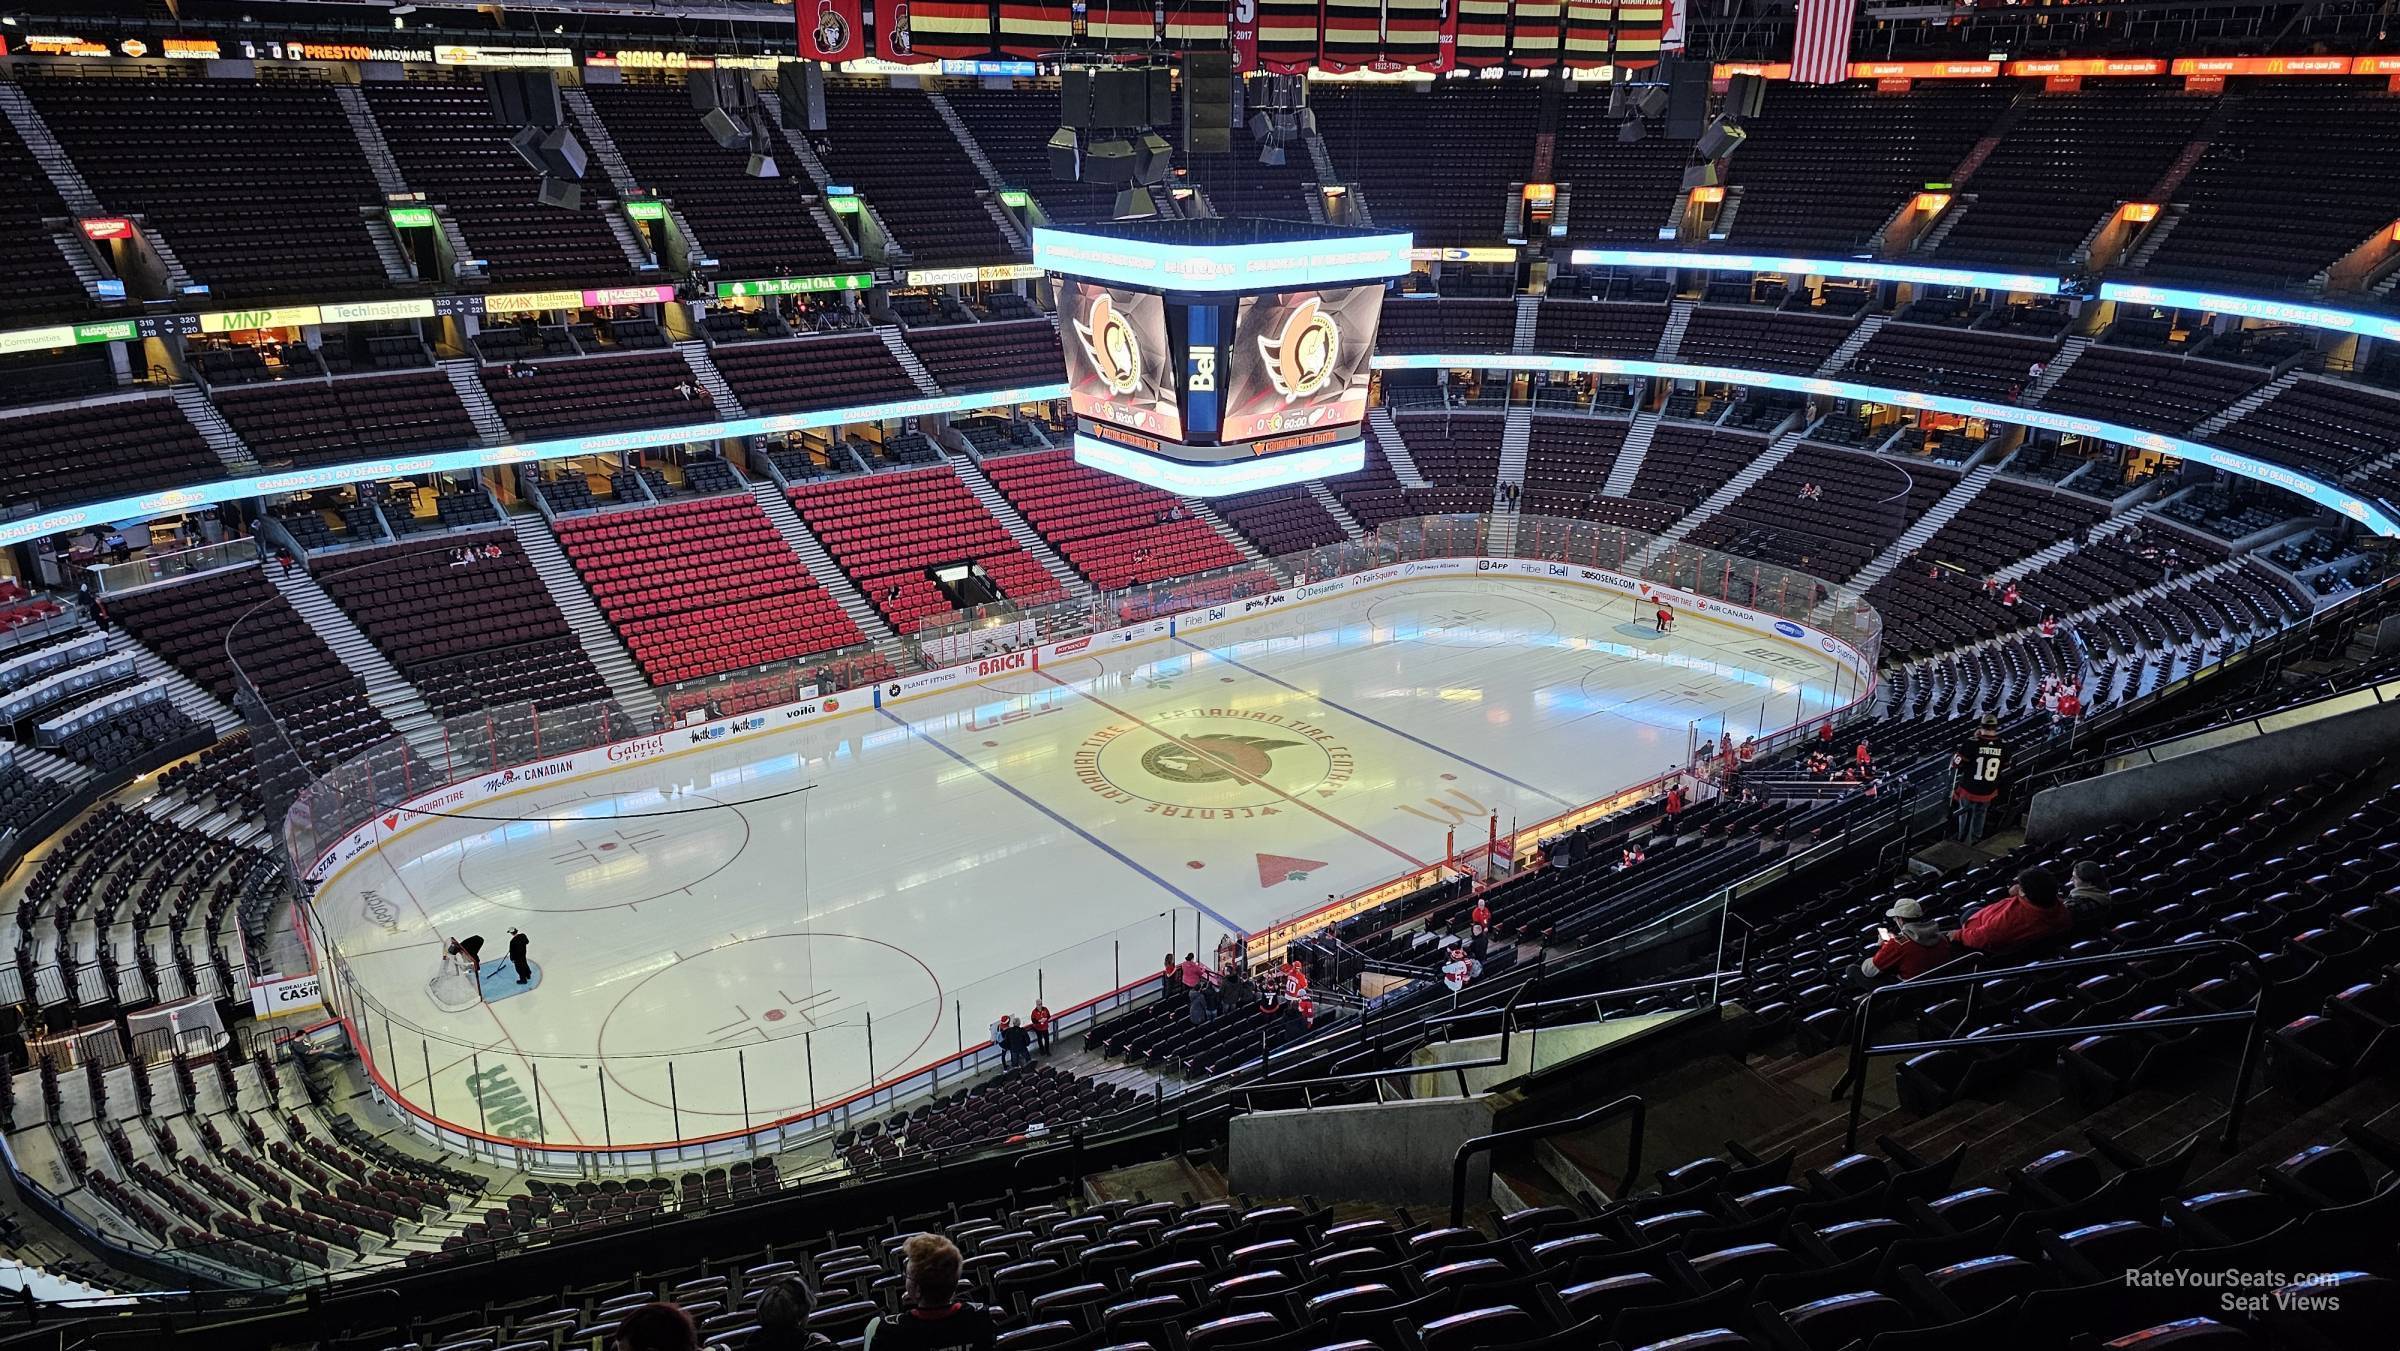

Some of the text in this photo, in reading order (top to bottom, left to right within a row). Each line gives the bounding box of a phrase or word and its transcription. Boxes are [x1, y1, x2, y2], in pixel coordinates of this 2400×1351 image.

[616, 50, 687, 68] SIGNS.CA
[925, 271, 974, 282] Decisive
[980, 267, 1012, 278] RE/MAX
[756, 276, 836, 293] The Royal Oak
[334, 302, 420, 318] TechInsights
[488, 295, 534, 310] RE/MAX
[179, 316, 196, 324] 320
[223, 311, 272, 330] MNP
[142, 329, 157, 337] 219
[182, 326, 198, 334] 220
[4, 334, 61, 348] Communities
[1189, 346, 1215, 392] Bell
[1284, 416, 1307, 428] 60:00
[2039, 416, 2069, 429] DEALER
[2071, 421, 2101, 433] GROUP
[256, 473, 316, 489] CANADA'S
[336, 469, 349, 479] RV
[350, 464, 392, 478] DEALER
[395, 459, 434, 471] GROUP
[0, 513, 87, 539] DEALER GROUP
[1362, 569, 1398, 584] FairSquare
[1521, 563, 1568, 577] Fibe Bell
[1308, 582, 1344, 596] Desjardins
[1185, 607, 1226, 627] Fibe Bell
[1722, 606, 1754, 621] CANADA
[964, 652, 1025, 677] The BRICK
[1744, 648, 1820, 670] BET99
[903, 673, 956, 690] PLANET FITNESS
[786, 703, 816, 720] voilà
[1288, 720, 1335, 742] TIRE
[607, 735, 663, 762] Gabriel
[625, 749, 665, 761] PIZZA
[484, 760, 573, 793] Molson CANADIAN
[1973, 756, 2000, 782] 18
[403, 790, 465, 821] CANADIAN TIRE
[318, 852, 337, 875] STAR
[279, 984, 302, 992] RIDEAU
[1266, 995, 1274, 1005] 7
